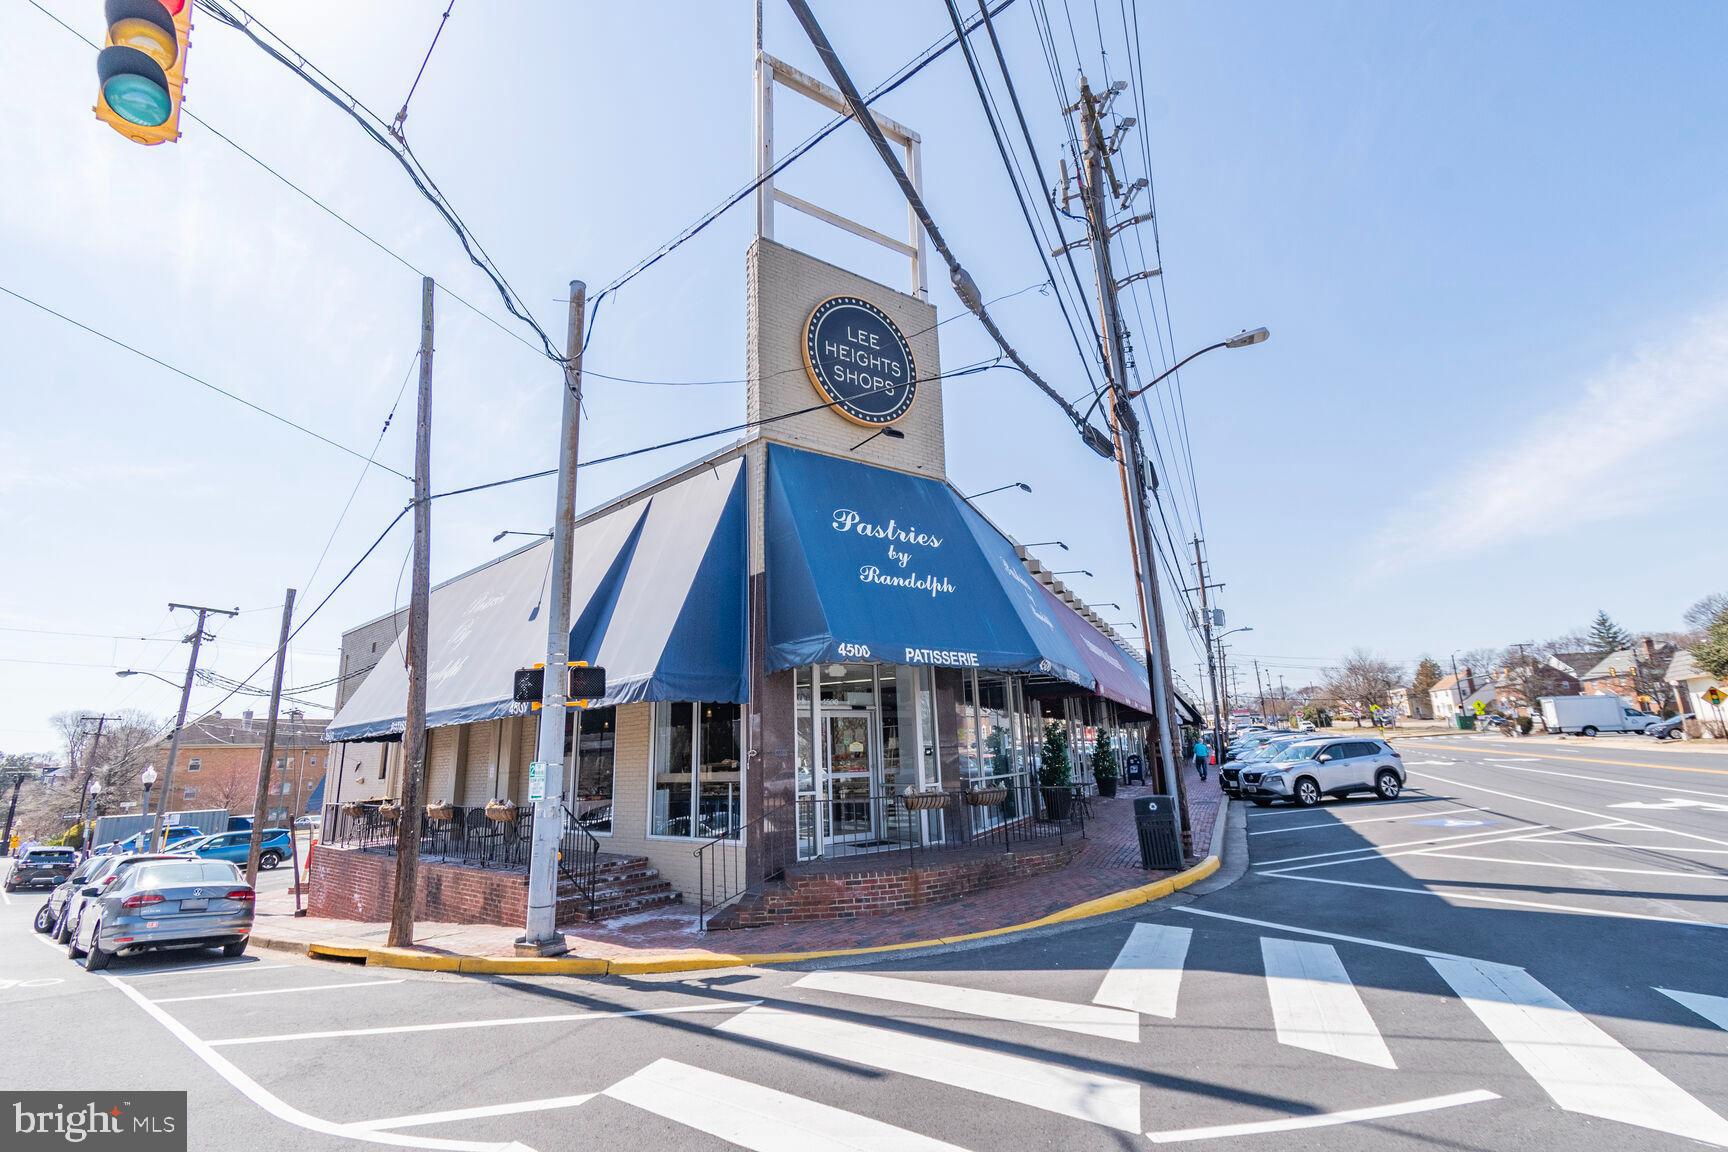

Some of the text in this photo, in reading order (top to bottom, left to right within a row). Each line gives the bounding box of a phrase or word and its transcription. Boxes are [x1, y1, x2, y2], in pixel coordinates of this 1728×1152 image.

[847, 326, 880, 350] LEE
[825, 340, 901, 377] HEIGHTS
[834, 365, 895, 396] SHOPS
[832, 508, 943, 548] Pastries
[888, 545, 912, 568] by
[860, 565, 956, 597] Randolph
[837, 642, 871, 658] 4500
[905, 647, 980, 667] PATISSERIE
